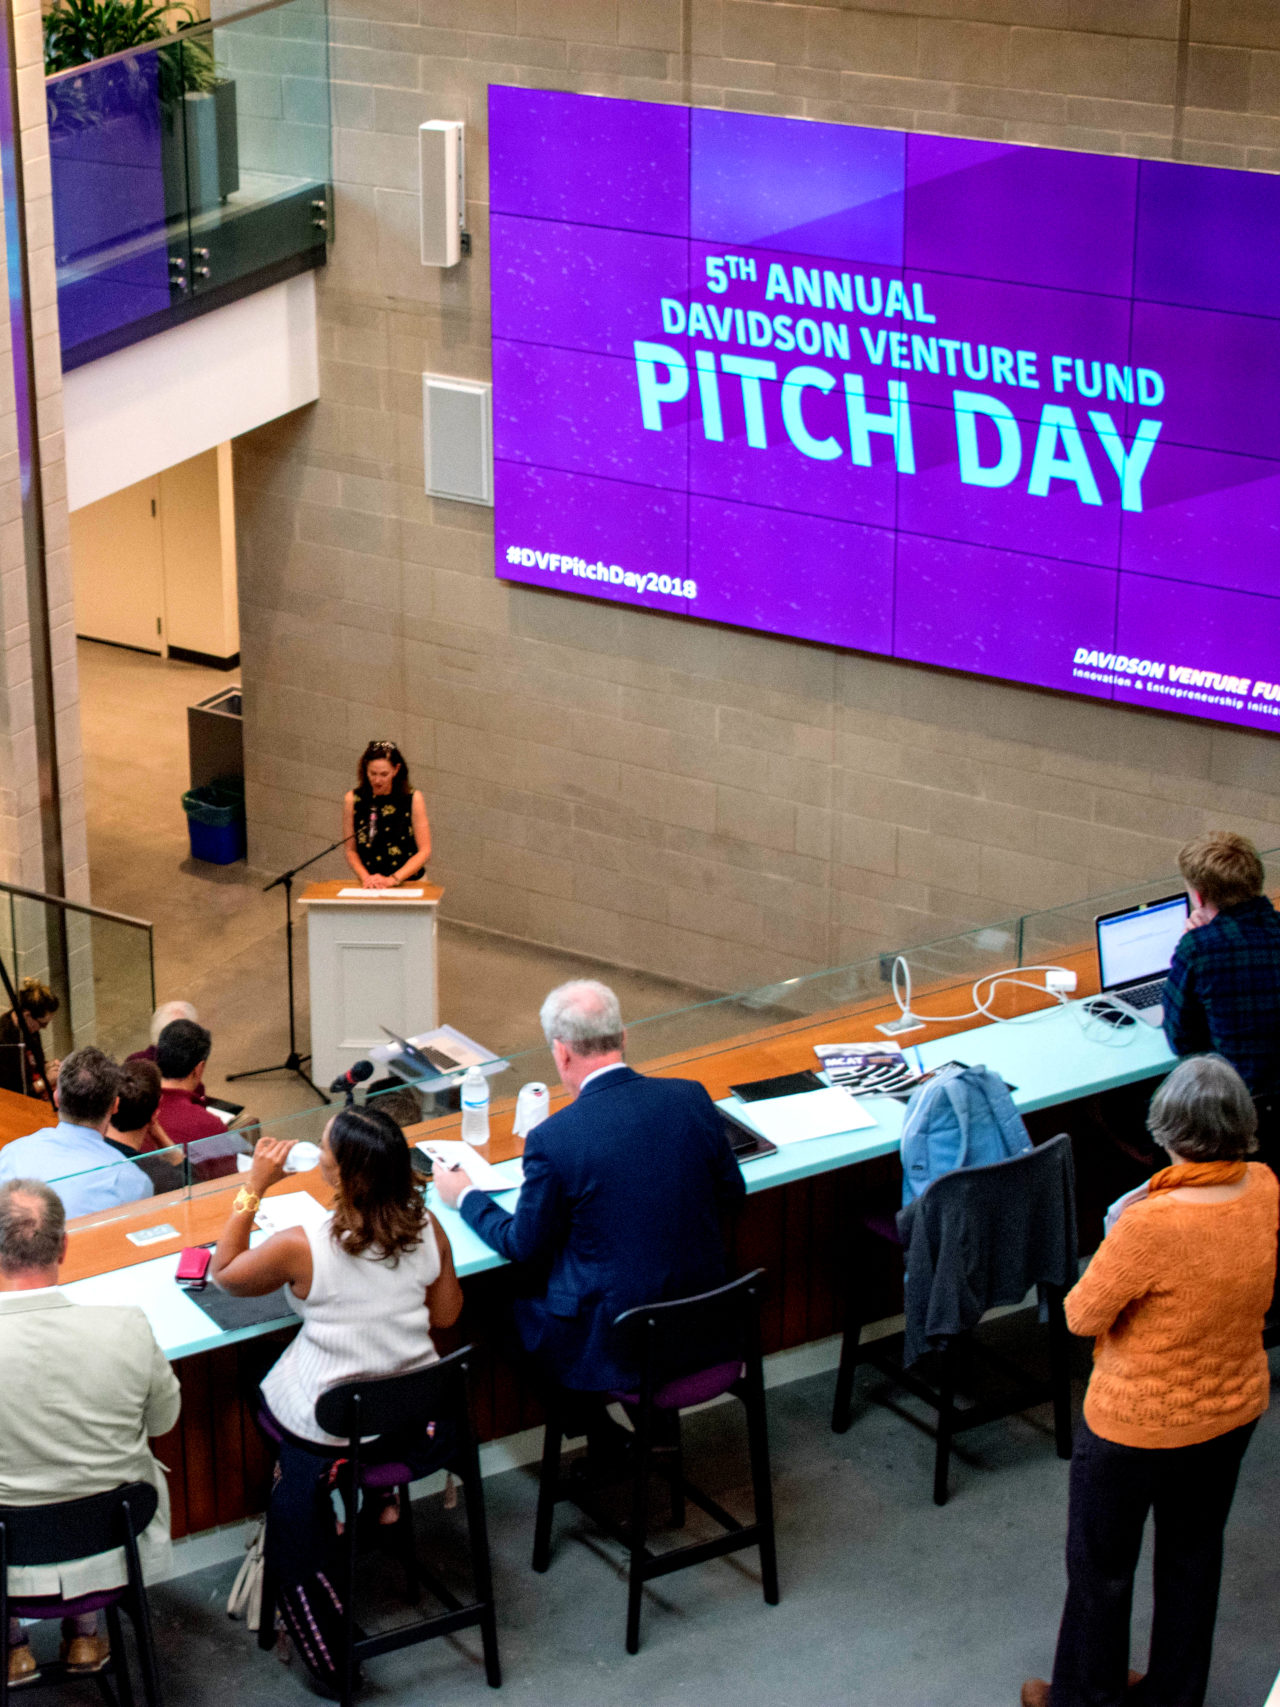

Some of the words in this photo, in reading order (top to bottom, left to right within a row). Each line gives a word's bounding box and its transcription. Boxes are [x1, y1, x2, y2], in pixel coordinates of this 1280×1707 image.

[705, 254, 758, 295] 5TH
[765, 262, 936, 325] ANNUAL
[660, 297, 851, 361] DAVIDSON
[859, 326, 1040, 390] VENTURE
[1051, 356, 1166, 408] FUND
[633, 340, 916, 475] PITCH
[953, 390, 1163, 513] DAY
[506, 545, 698, 600] #DVFPitchDay2018
[1072, 667, 1132, 688] Innovation
[1134, 678, 1143, 690] &
[1146, 681, 1244, 711] Entrepreneurship
[1247, 700, 1280, 717] Initia
[1073, 647, 1166, 679] DAVIDSON
[1168, 664, 1251, 696] VENTURE
